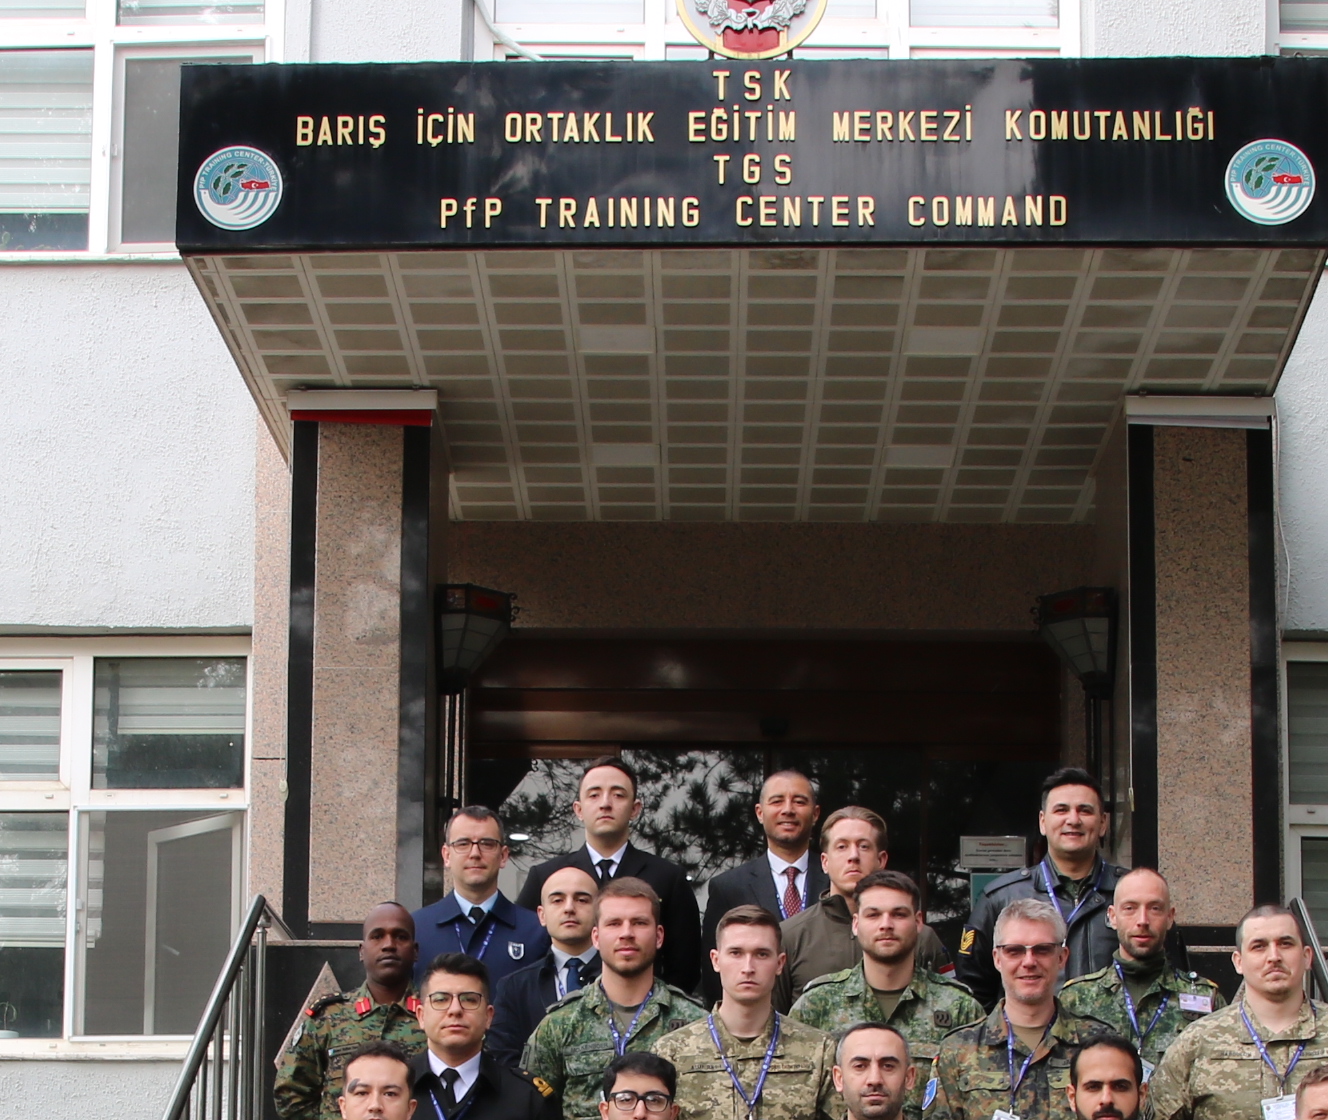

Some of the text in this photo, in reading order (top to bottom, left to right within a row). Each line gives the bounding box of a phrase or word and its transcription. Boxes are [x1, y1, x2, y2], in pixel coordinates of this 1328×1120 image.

[713, 69, 793, 98] TSK
[296, 104, 1215, 147] BARIŞ İÇİN ORTAKLIK EĞİTİM MERKEZİ KOMUTANLIĞI
[202, 152, 232, 175] TRAINING
[714, 152, 792, 183] TGS
[1233, 145, 1263, 168] TRAINING
[440, 194, 1067, 227] PfP TRAINING CENTER COMMAND
